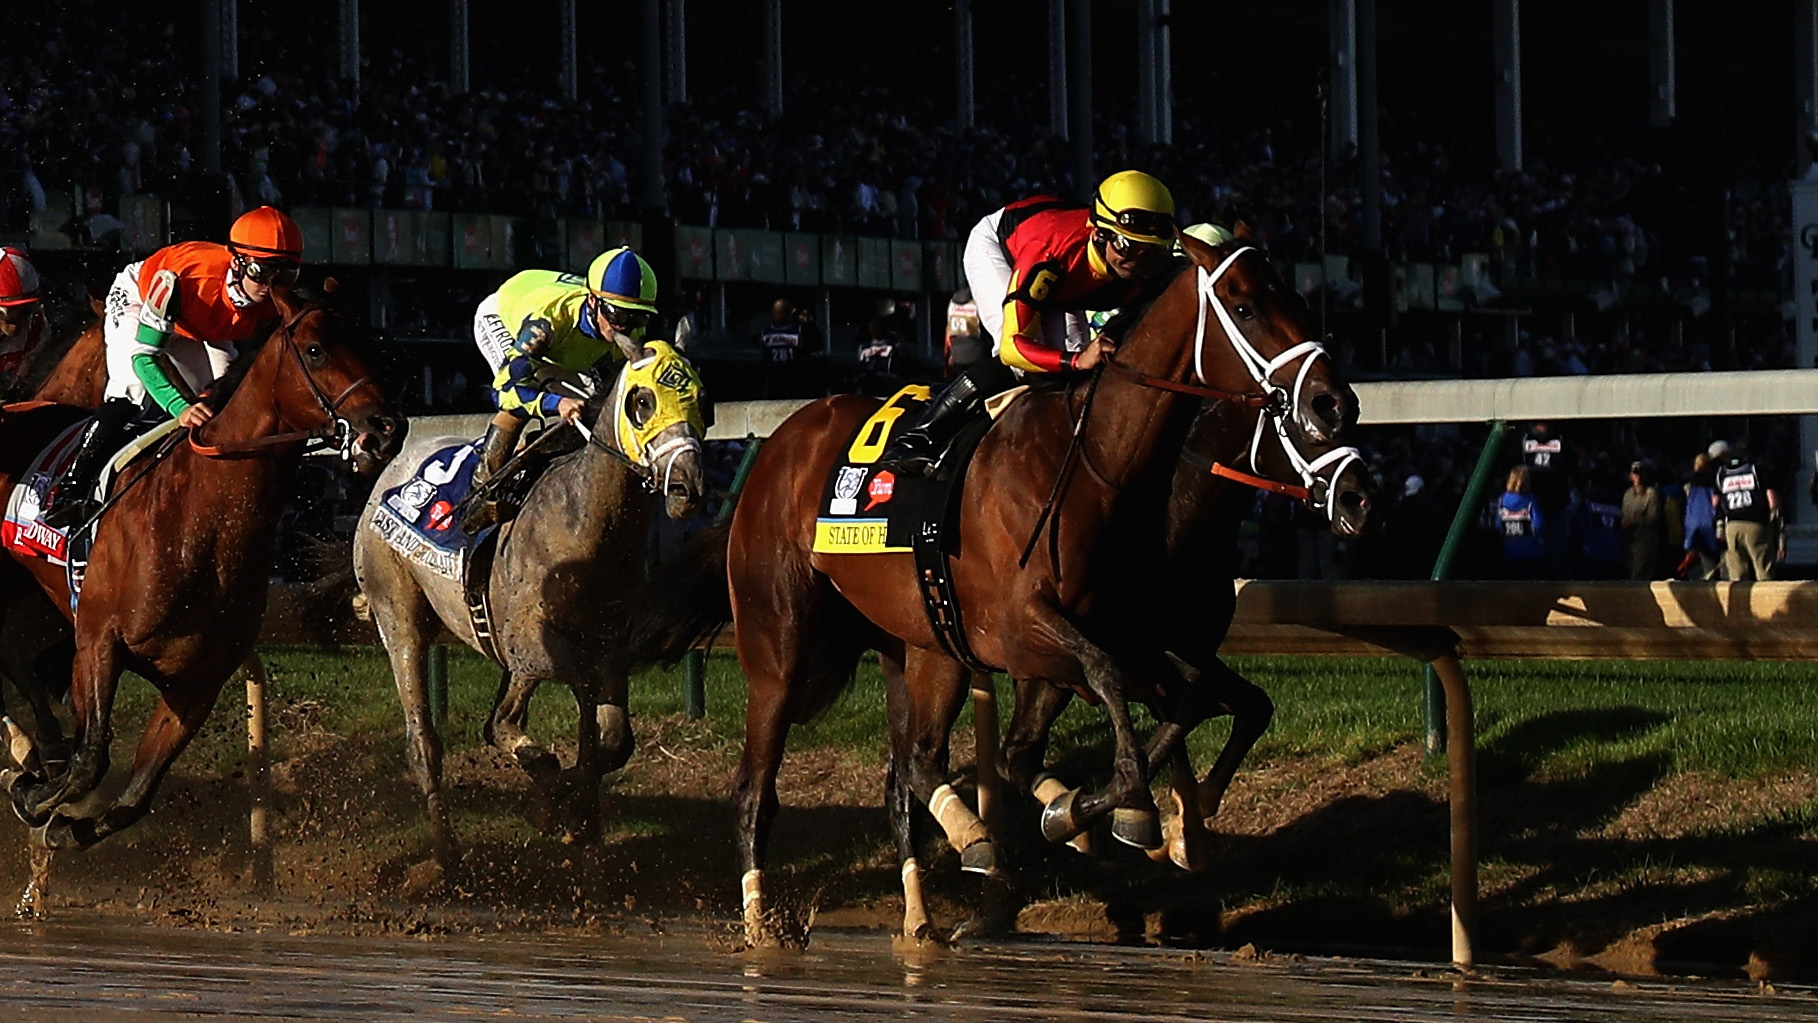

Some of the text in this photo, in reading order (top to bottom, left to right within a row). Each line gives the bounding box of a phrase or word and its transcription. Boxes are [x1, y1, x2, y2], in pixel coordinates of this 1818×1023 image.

[1028, 269, 1059, 301] 6
[847, 383, 933, 465] 6
[828, 526, 860, 546] STATE
[861, 526, 876, 546] OF
